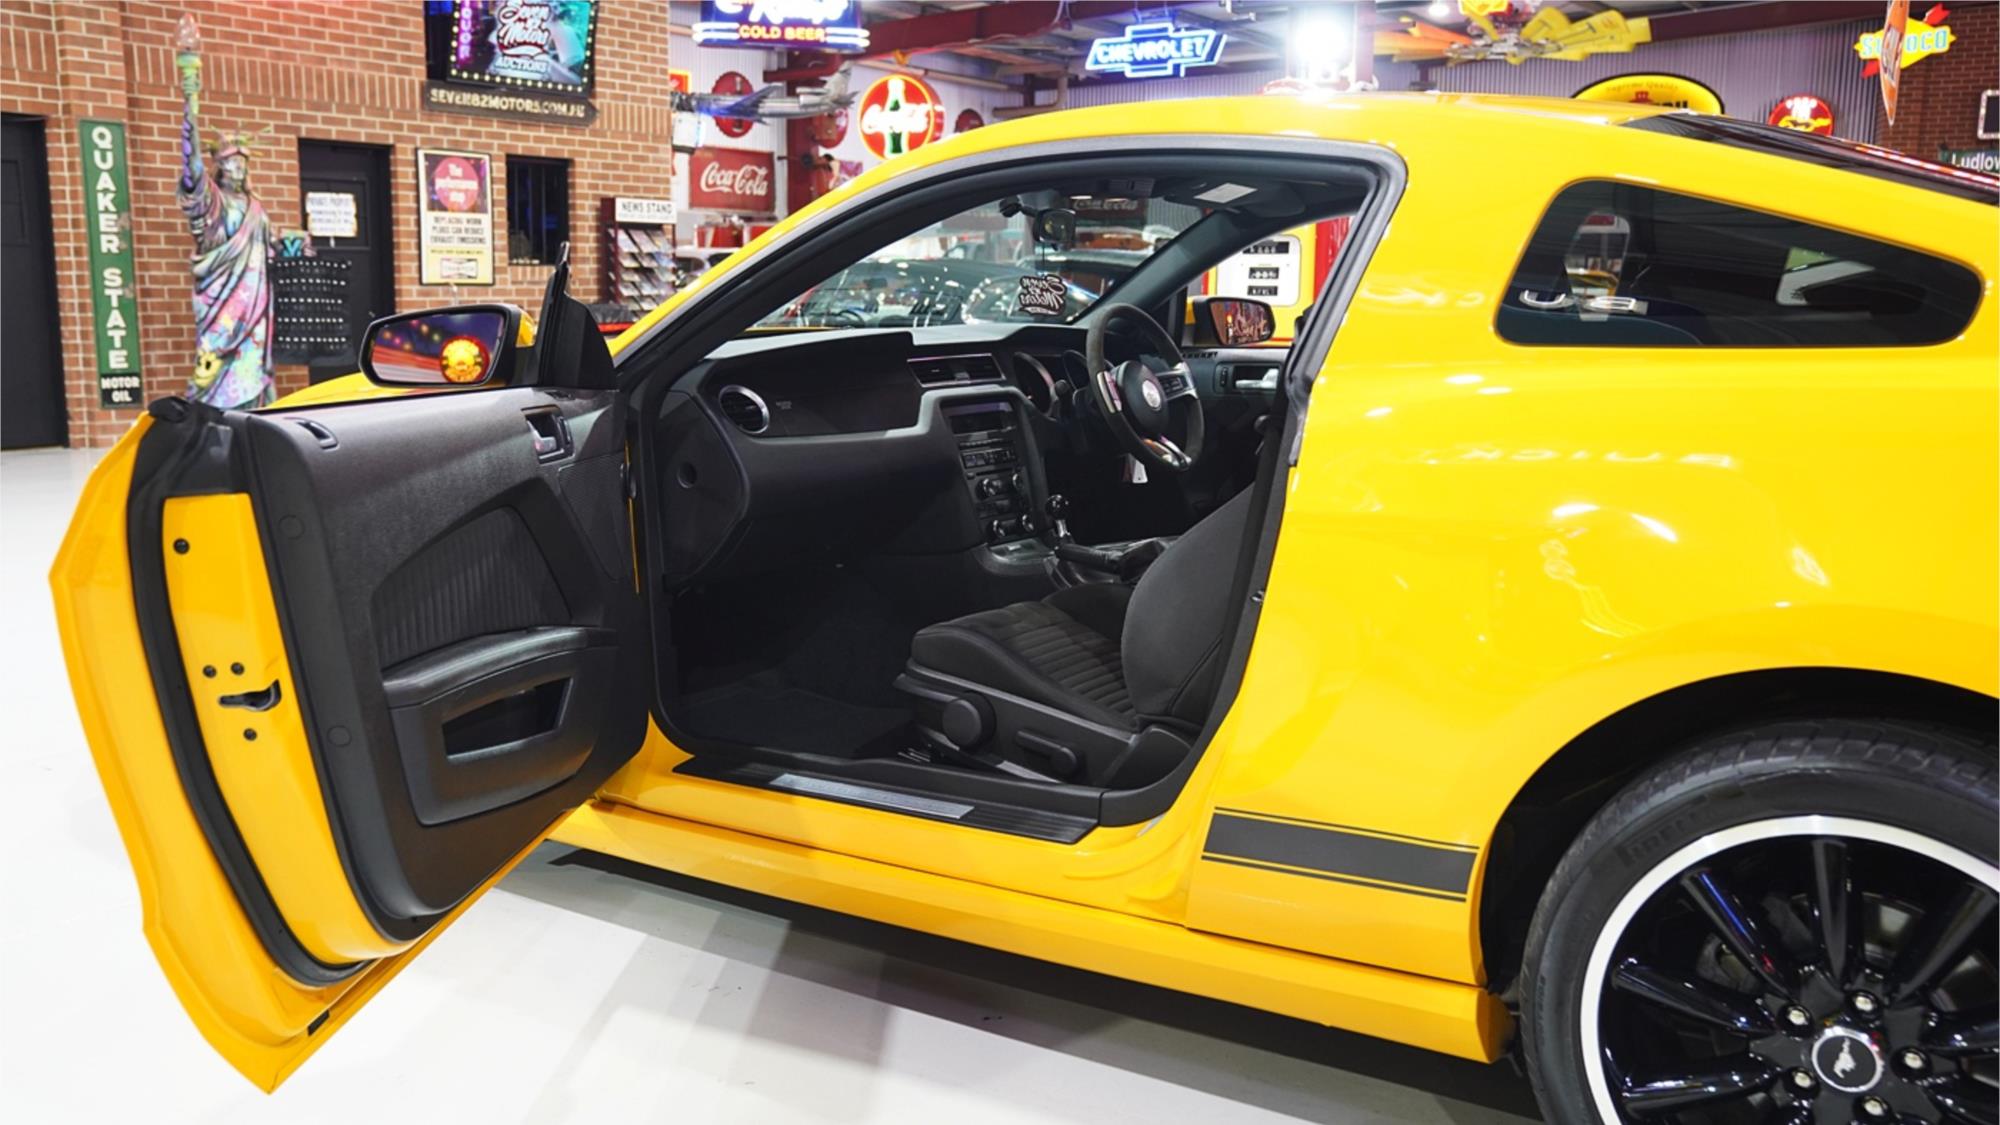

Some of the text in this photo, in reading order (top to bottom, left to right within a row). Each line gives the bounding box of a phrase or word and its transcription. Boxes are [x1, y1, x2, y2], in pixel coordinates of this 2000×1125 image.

[739, 24, 826, 42] COLD BEER
[1862, 29, 1947, 56] SOCO
[1096, 37, 1206, 63] CHEVROLET
[91, 126, 120, 253] QUAKER
[700, 160, 768, 196] Coca-Cola
[622, 201, 673, 215] NEWS STAND
[103, 267, 129, 369] STATE
[101, 376, 140, 389] MOTOR
[111, 389, 132, 402] OIL
